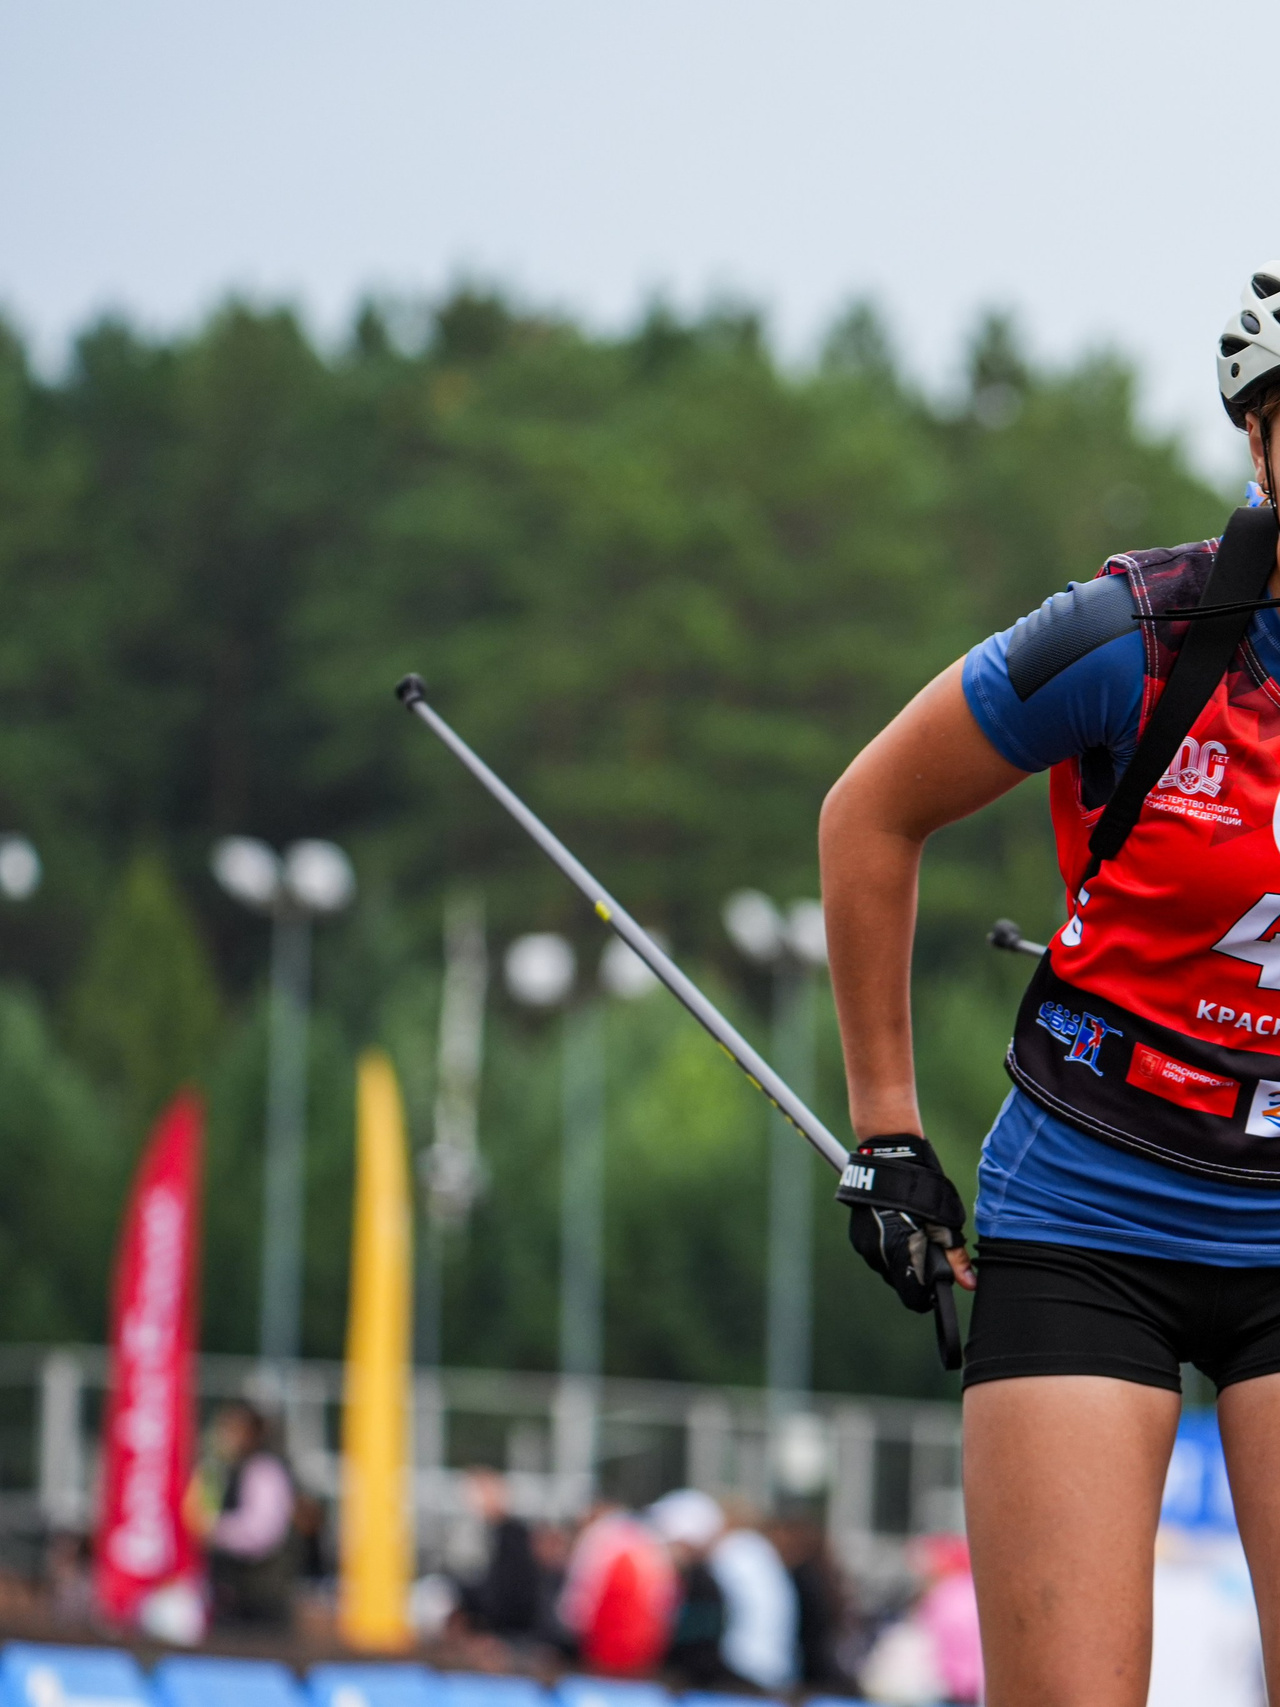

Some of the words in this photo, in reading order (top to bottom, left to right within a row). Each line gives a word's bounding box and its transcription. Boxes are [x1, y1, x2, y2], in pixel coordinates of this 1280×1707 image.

[1211, 754, 1230, 764] ЛЕТ
[1206, 803, 1239, 816] СПОРТА
[1187, 809, 1242, 826] ФЕДЕРАЦИИ
[1162, 1069, 1186, 1084] КРАЙ
